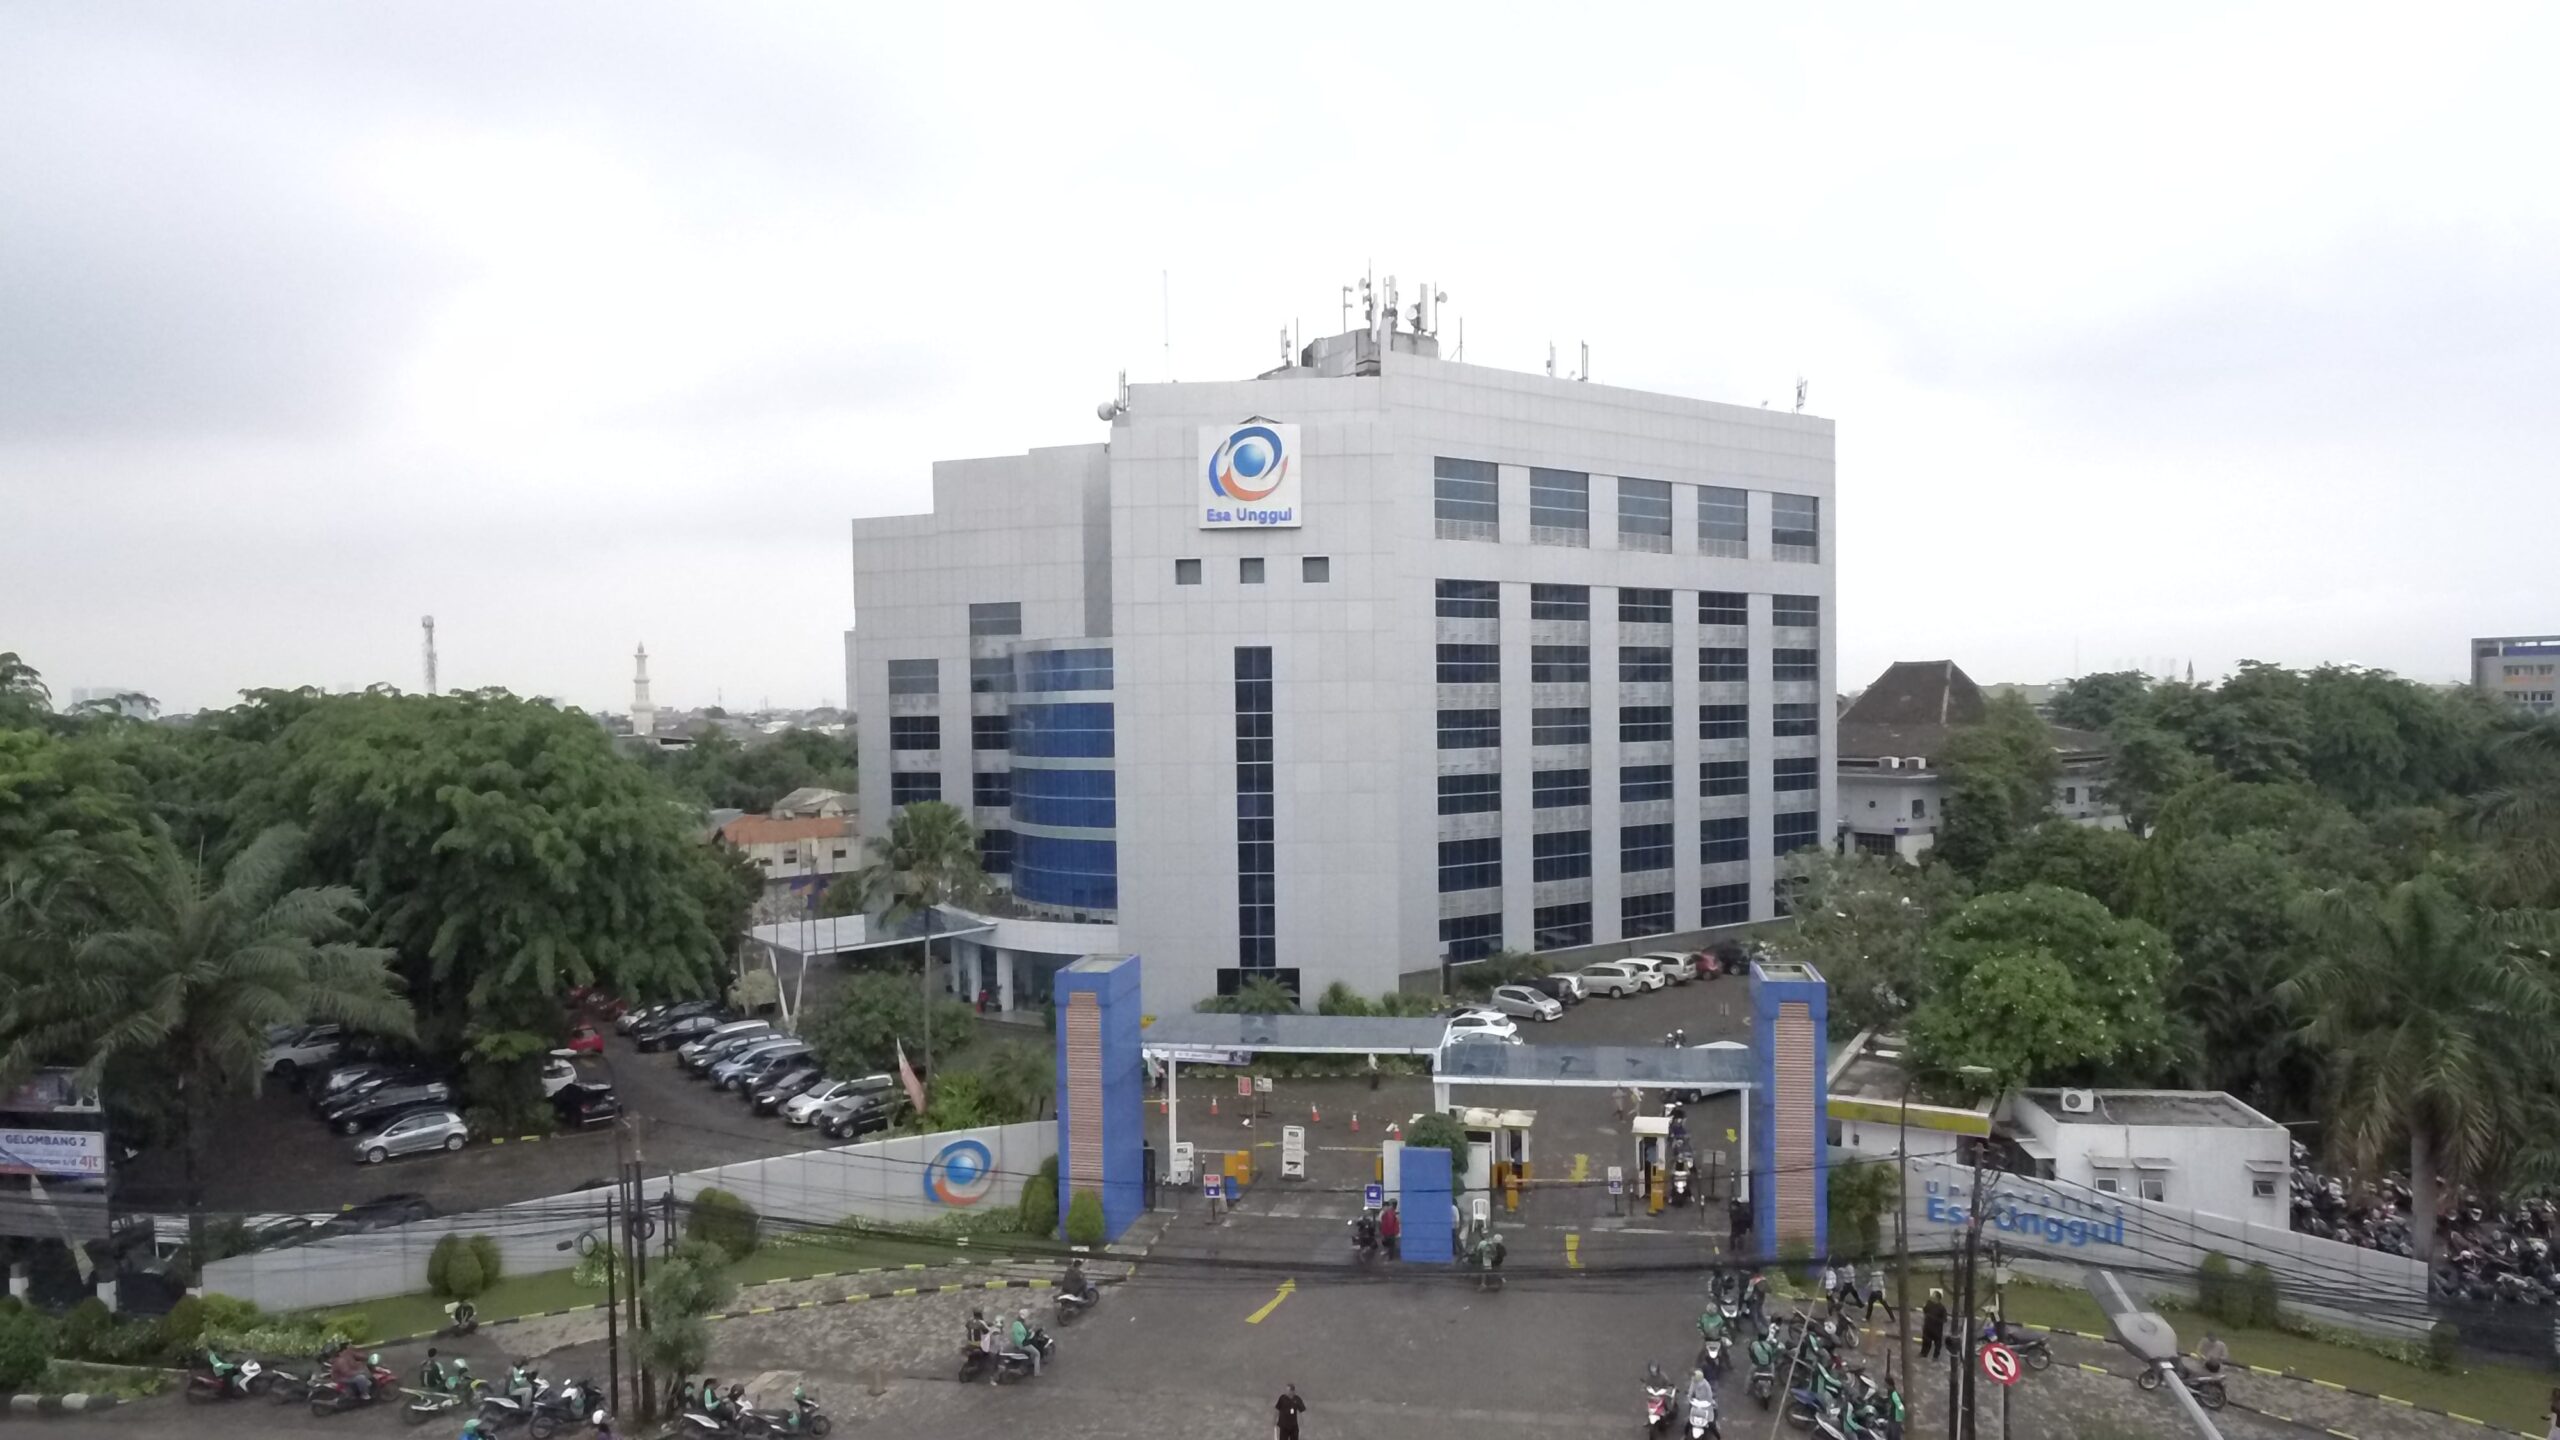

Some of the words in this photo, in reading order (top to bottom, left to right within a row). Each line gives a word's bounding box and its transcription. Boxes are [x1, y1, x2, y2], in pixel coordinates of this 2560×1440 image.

[1207, 509, 1231, 522] Esa
[1236, 508, 1292, 524] Unggul
[5, 1135, 77, 1146] GELOMBANG
[80, 1137, 86, 1147] 2
